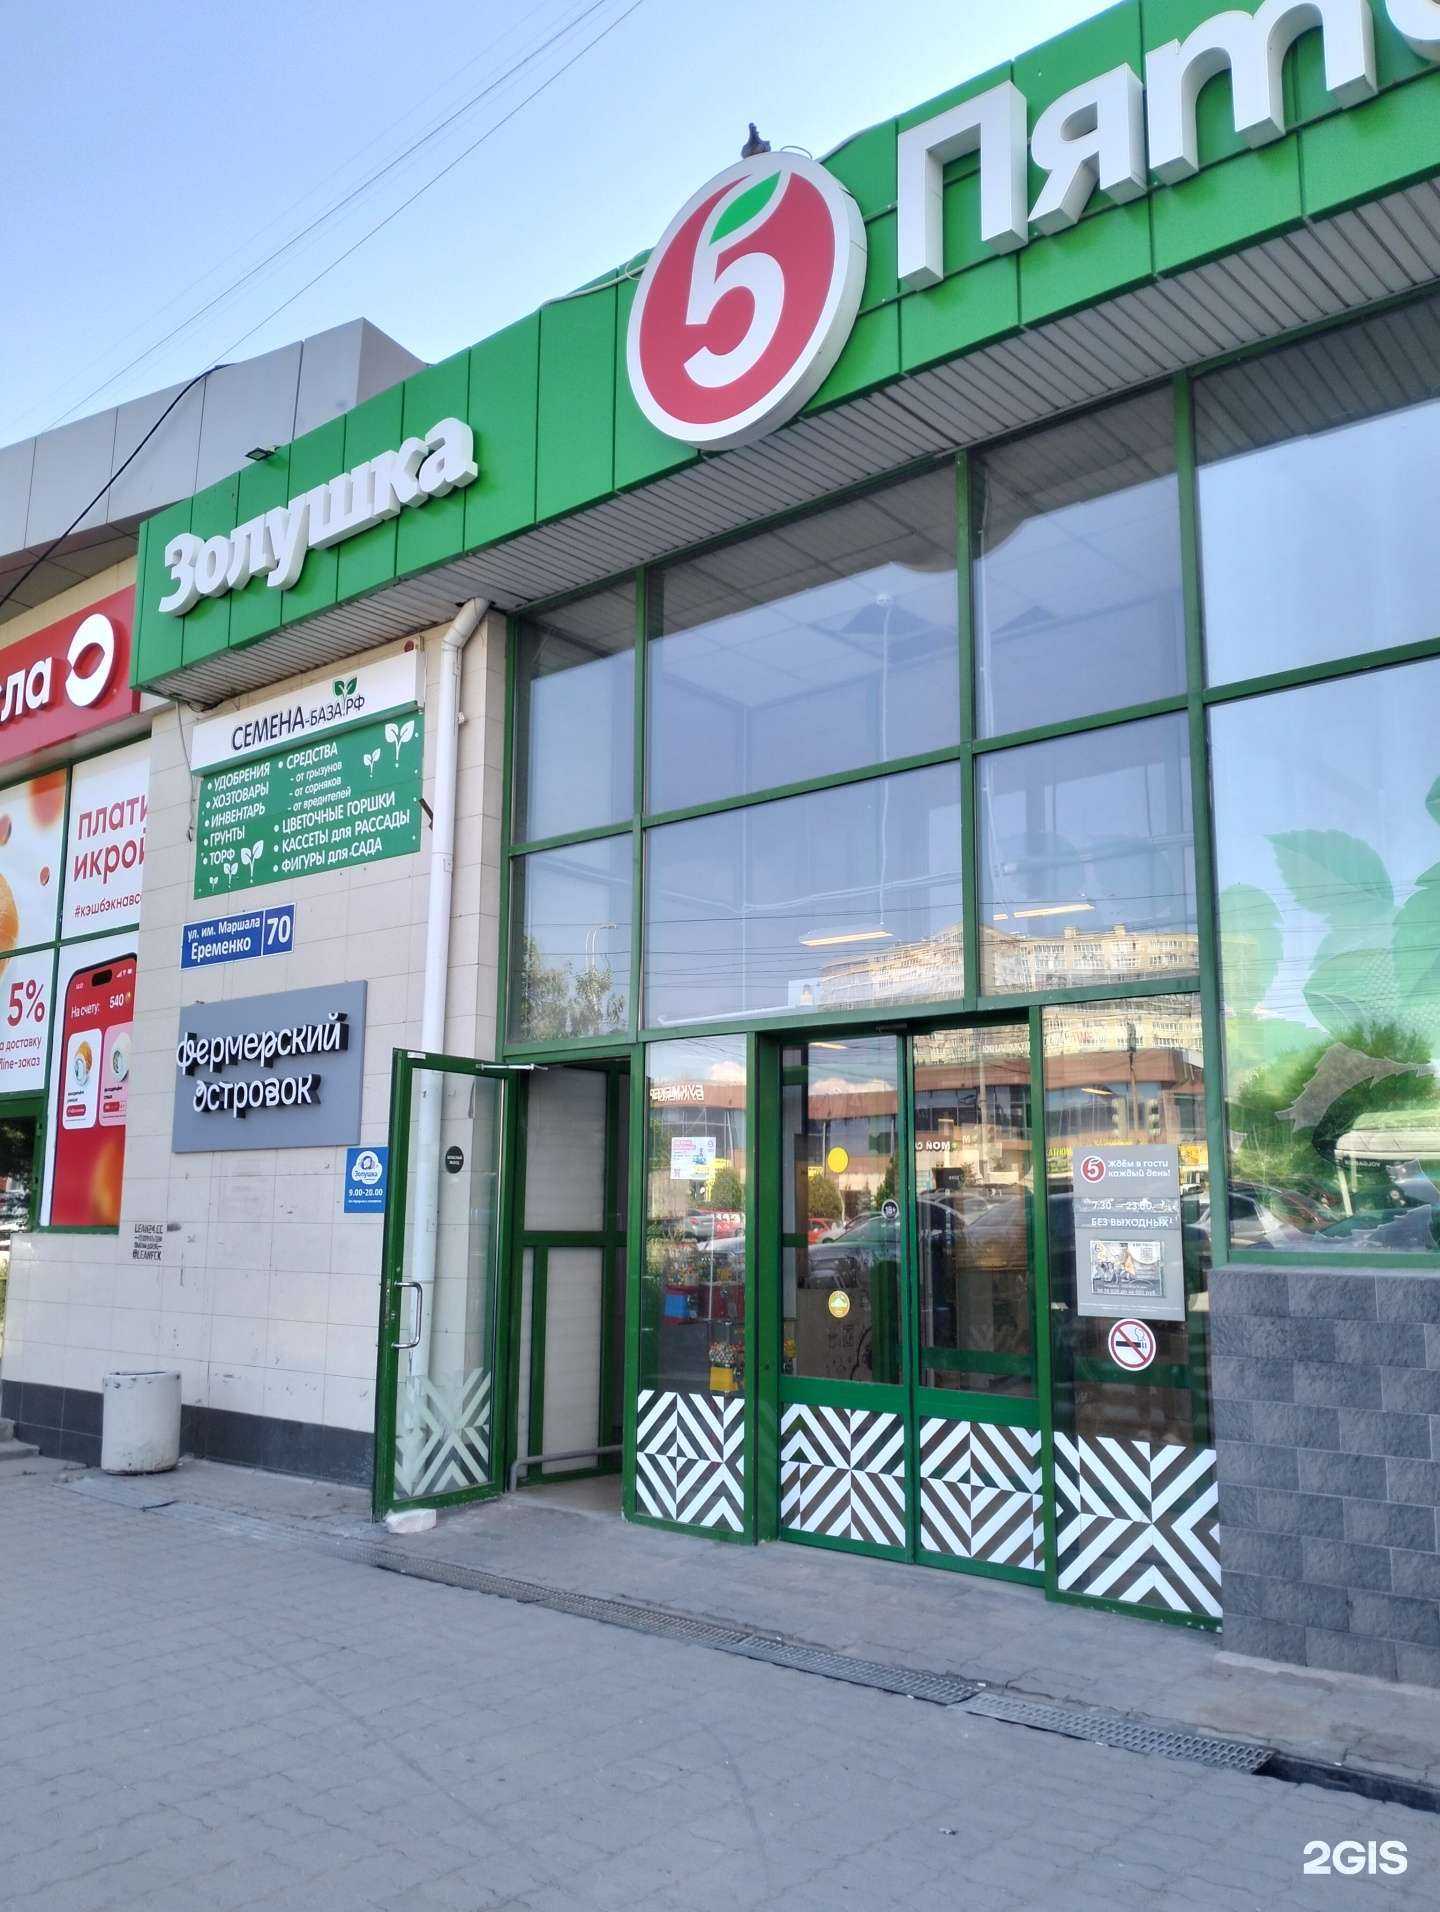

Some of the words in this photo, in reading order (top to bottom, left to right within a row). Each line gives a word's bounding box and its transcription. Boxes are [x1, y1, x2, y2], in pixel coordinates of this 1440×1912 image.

[158, 417, 478, 617] Золушка
[0, 656, 54, 723] ла
[286, 741, 338, 769] СРЕДСТВА
[213, 762, 271, 792] УДОБРЕНИЯ
[306, 761, 342, 781] грызунов
[211, 781, 269, 810] ХОЗТОВАРЫ
[303, 786, 351, 811] вредителей
[304, 777, 342, 796] сорняков
[210, 802, 266, 829] ИНВЕНТАРЬ
[282, 804, 344, 834] ЦВЕТОЧНЫЕ
[346, 791, 396, 817] ГОРШКИ
[209, 825, 246, 847] ГРУНТЫ
[282, 828, 329, 854] КАССЕТЫ
[330, 826, 352, 843] для
[354, 809, 410, 836] РАССАДЫ
[209, 848, 236, 866] ТОРФ
[281, 849, 326, 873] ФИГУРЫ
[327, 847, 348, 863] для
[351, 837, 383, 857] САДА
[187, 929, 200, 943] ул.
[201, 926, 216, 937] им.
[218, 917, 261, 935] Маршала
[266, 914, 291, 946] 70
[191, 937, 252, 963] Еременко
[7, 979, 46, 1027] 5%
[109, 993, 124, 1009] 540
[176, 1012, 346, 1076] фермерский
[193, 1073, 316, 1119] островок
